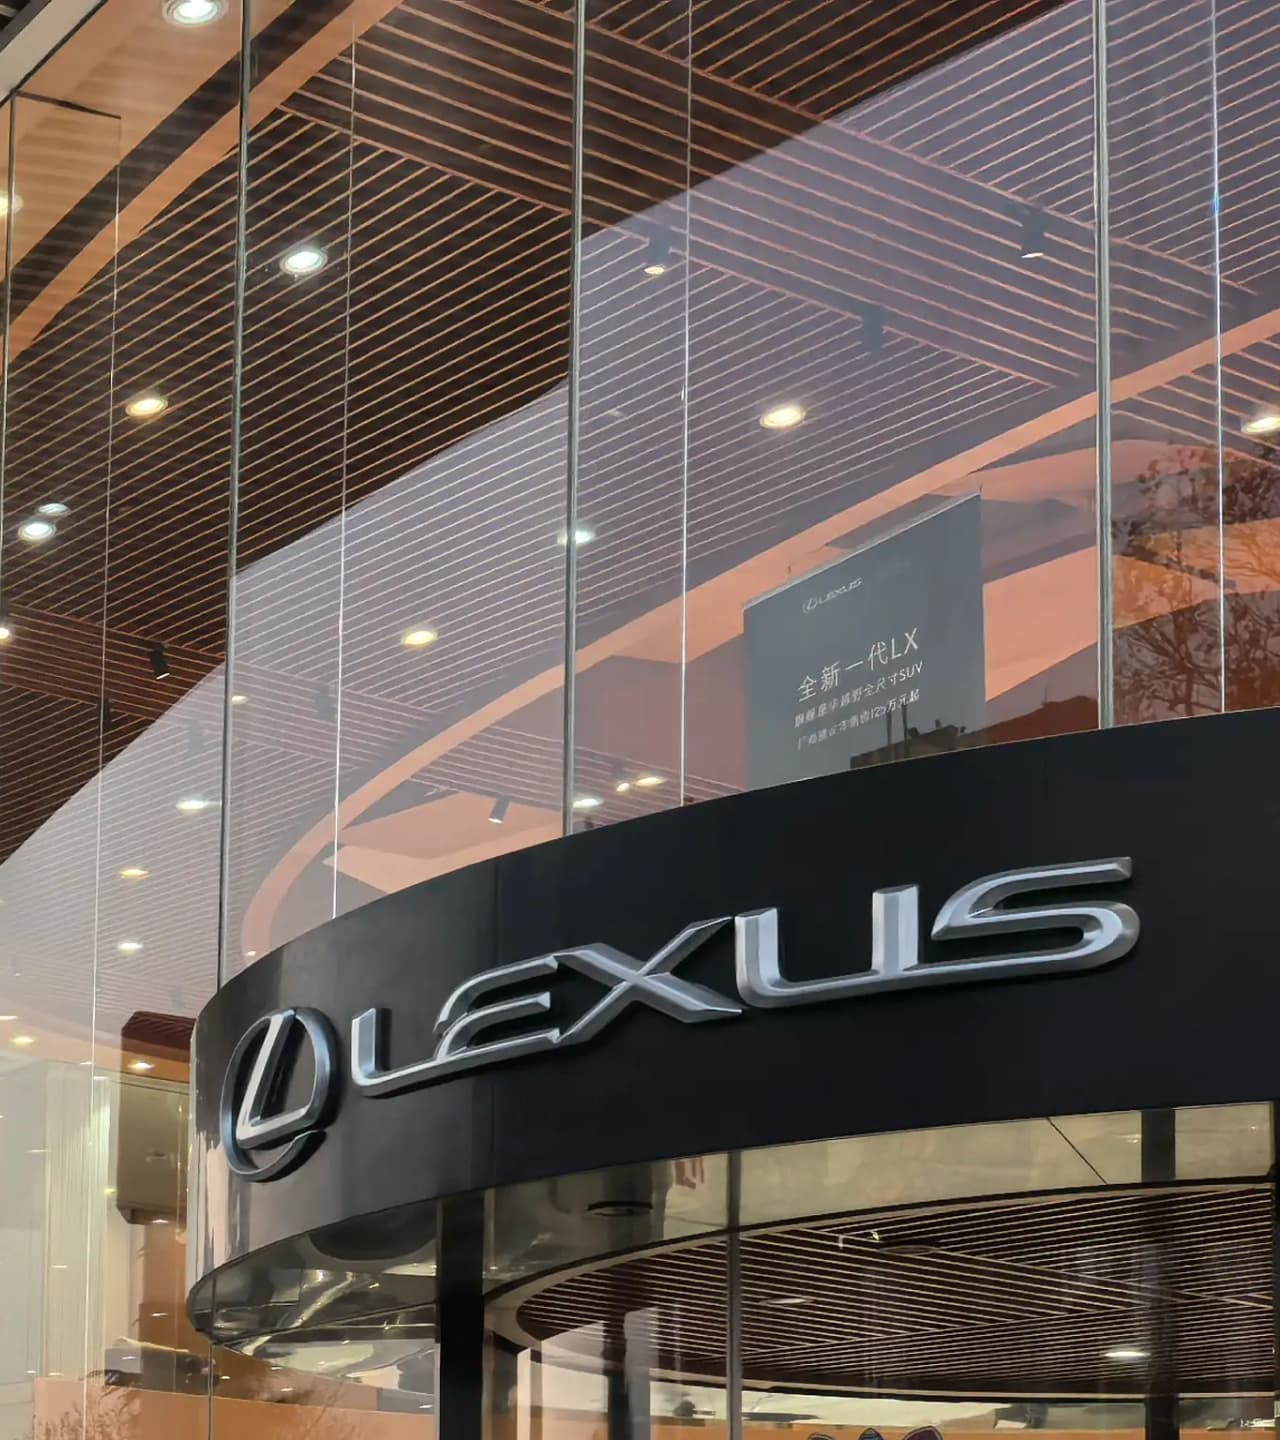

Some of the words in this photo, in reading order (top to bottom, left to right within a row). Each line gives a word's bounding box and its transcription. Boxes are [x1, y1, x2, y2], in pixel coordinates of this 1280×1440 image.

[797, 627, 920, 703] 全新一代LX
[349, 856, 1140, 1098] LEXUS
